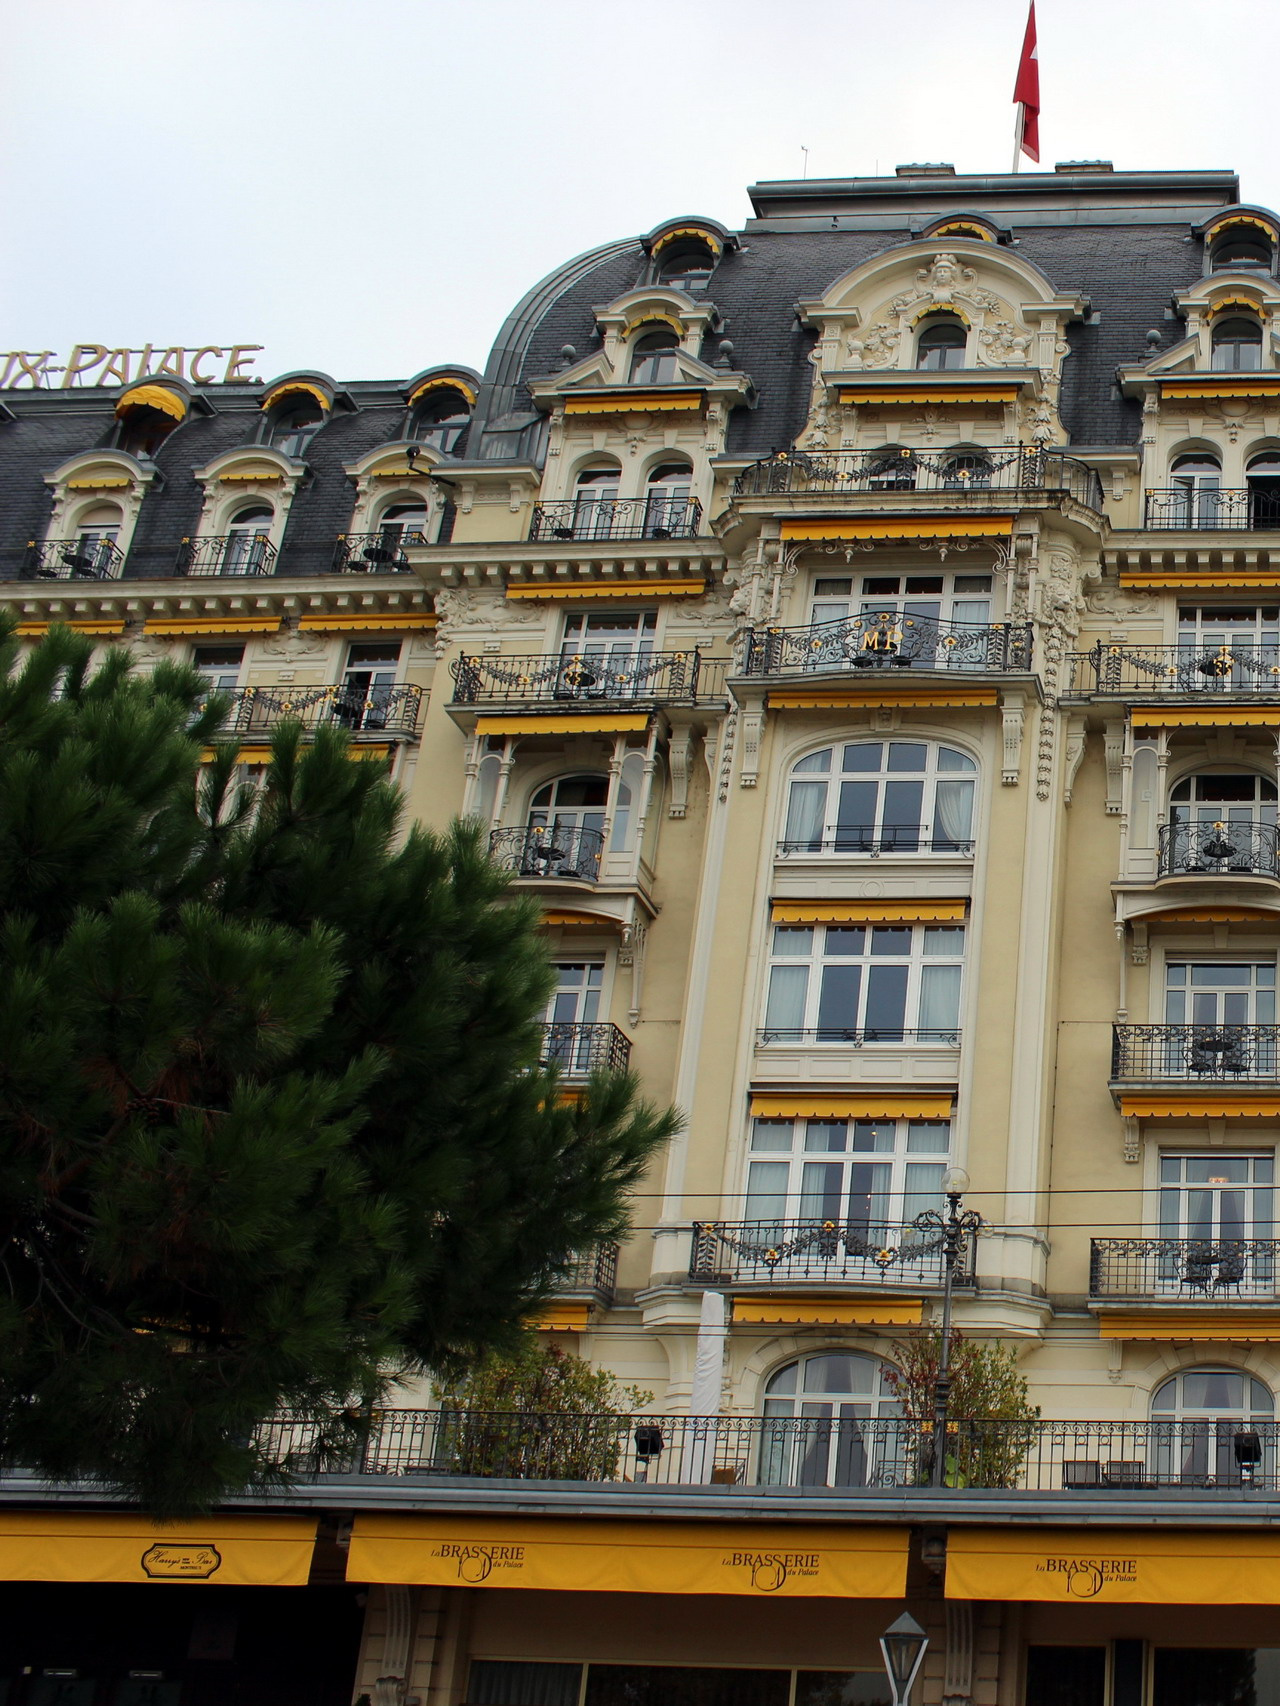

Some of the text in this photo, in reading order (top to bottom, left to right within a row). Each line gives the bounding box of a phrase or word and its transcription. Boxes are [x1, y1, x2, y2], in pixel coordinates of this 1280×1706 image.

[441, 1545, 525, 1559] BRASSERIE
[732, 1553, 820, 1567] BRASSERIE
[1046, 1559, 1137, 1573] BRASSERIE
